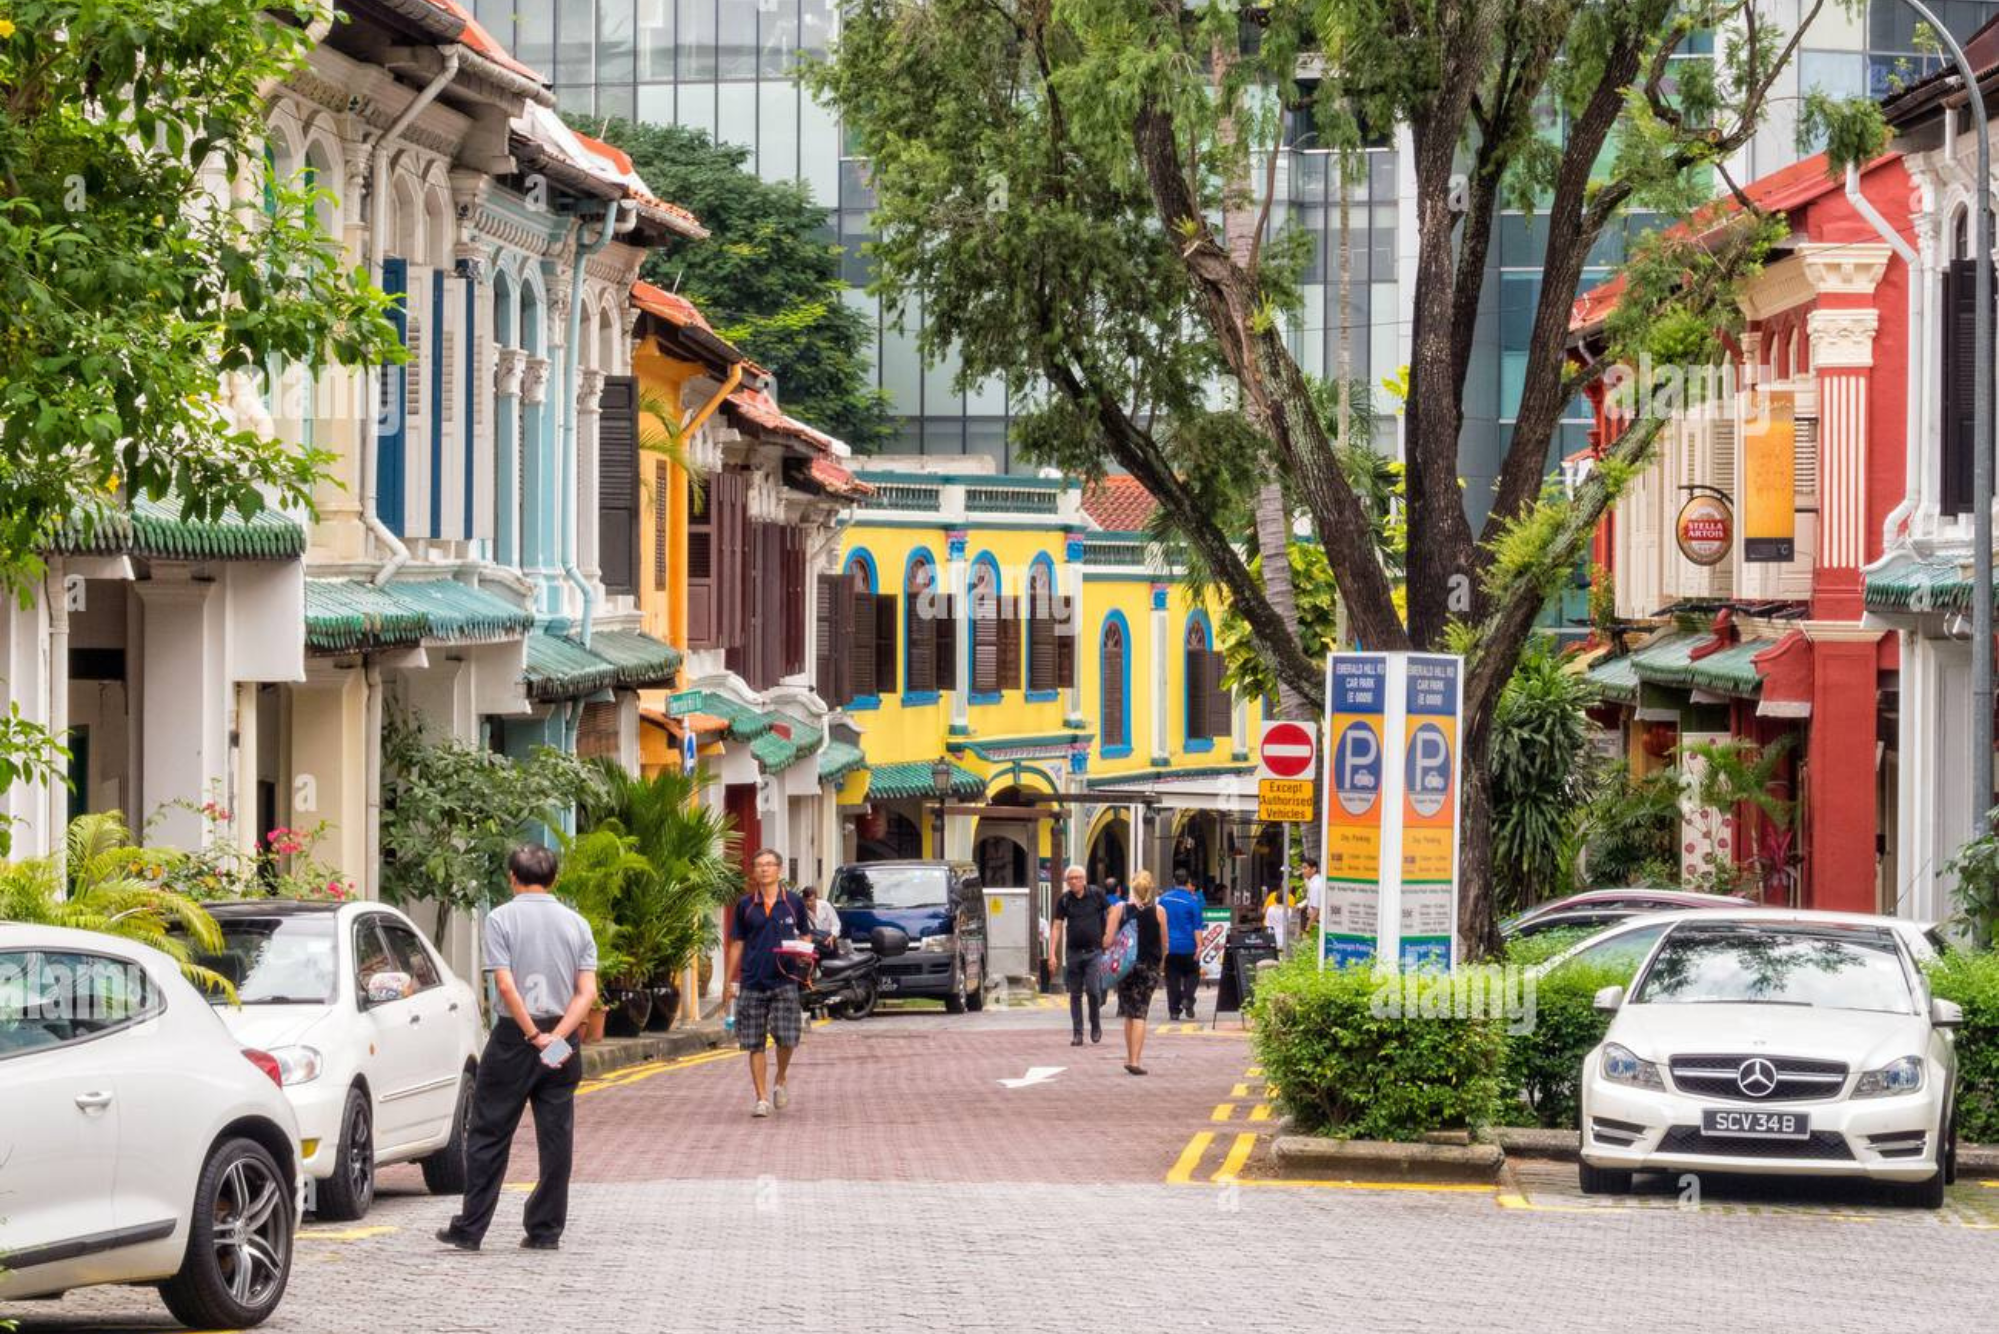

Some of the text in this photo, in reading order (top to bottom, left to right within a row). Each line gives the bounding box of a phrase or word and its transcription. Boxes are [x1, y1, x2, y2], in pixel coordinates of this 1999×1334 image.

[1688, 521, 1723, 530] STELLA
[1688, 530, 1724, 538] ARTOIS
[1345, 677, 1358, 689] CAR
[1417, 679, 1429, 691] CAR
[1269, 781, 1303, 795] Except
[1260, 795, 1312, 807] Authorised
[1266, 807, 1305, 819] Vehicles
